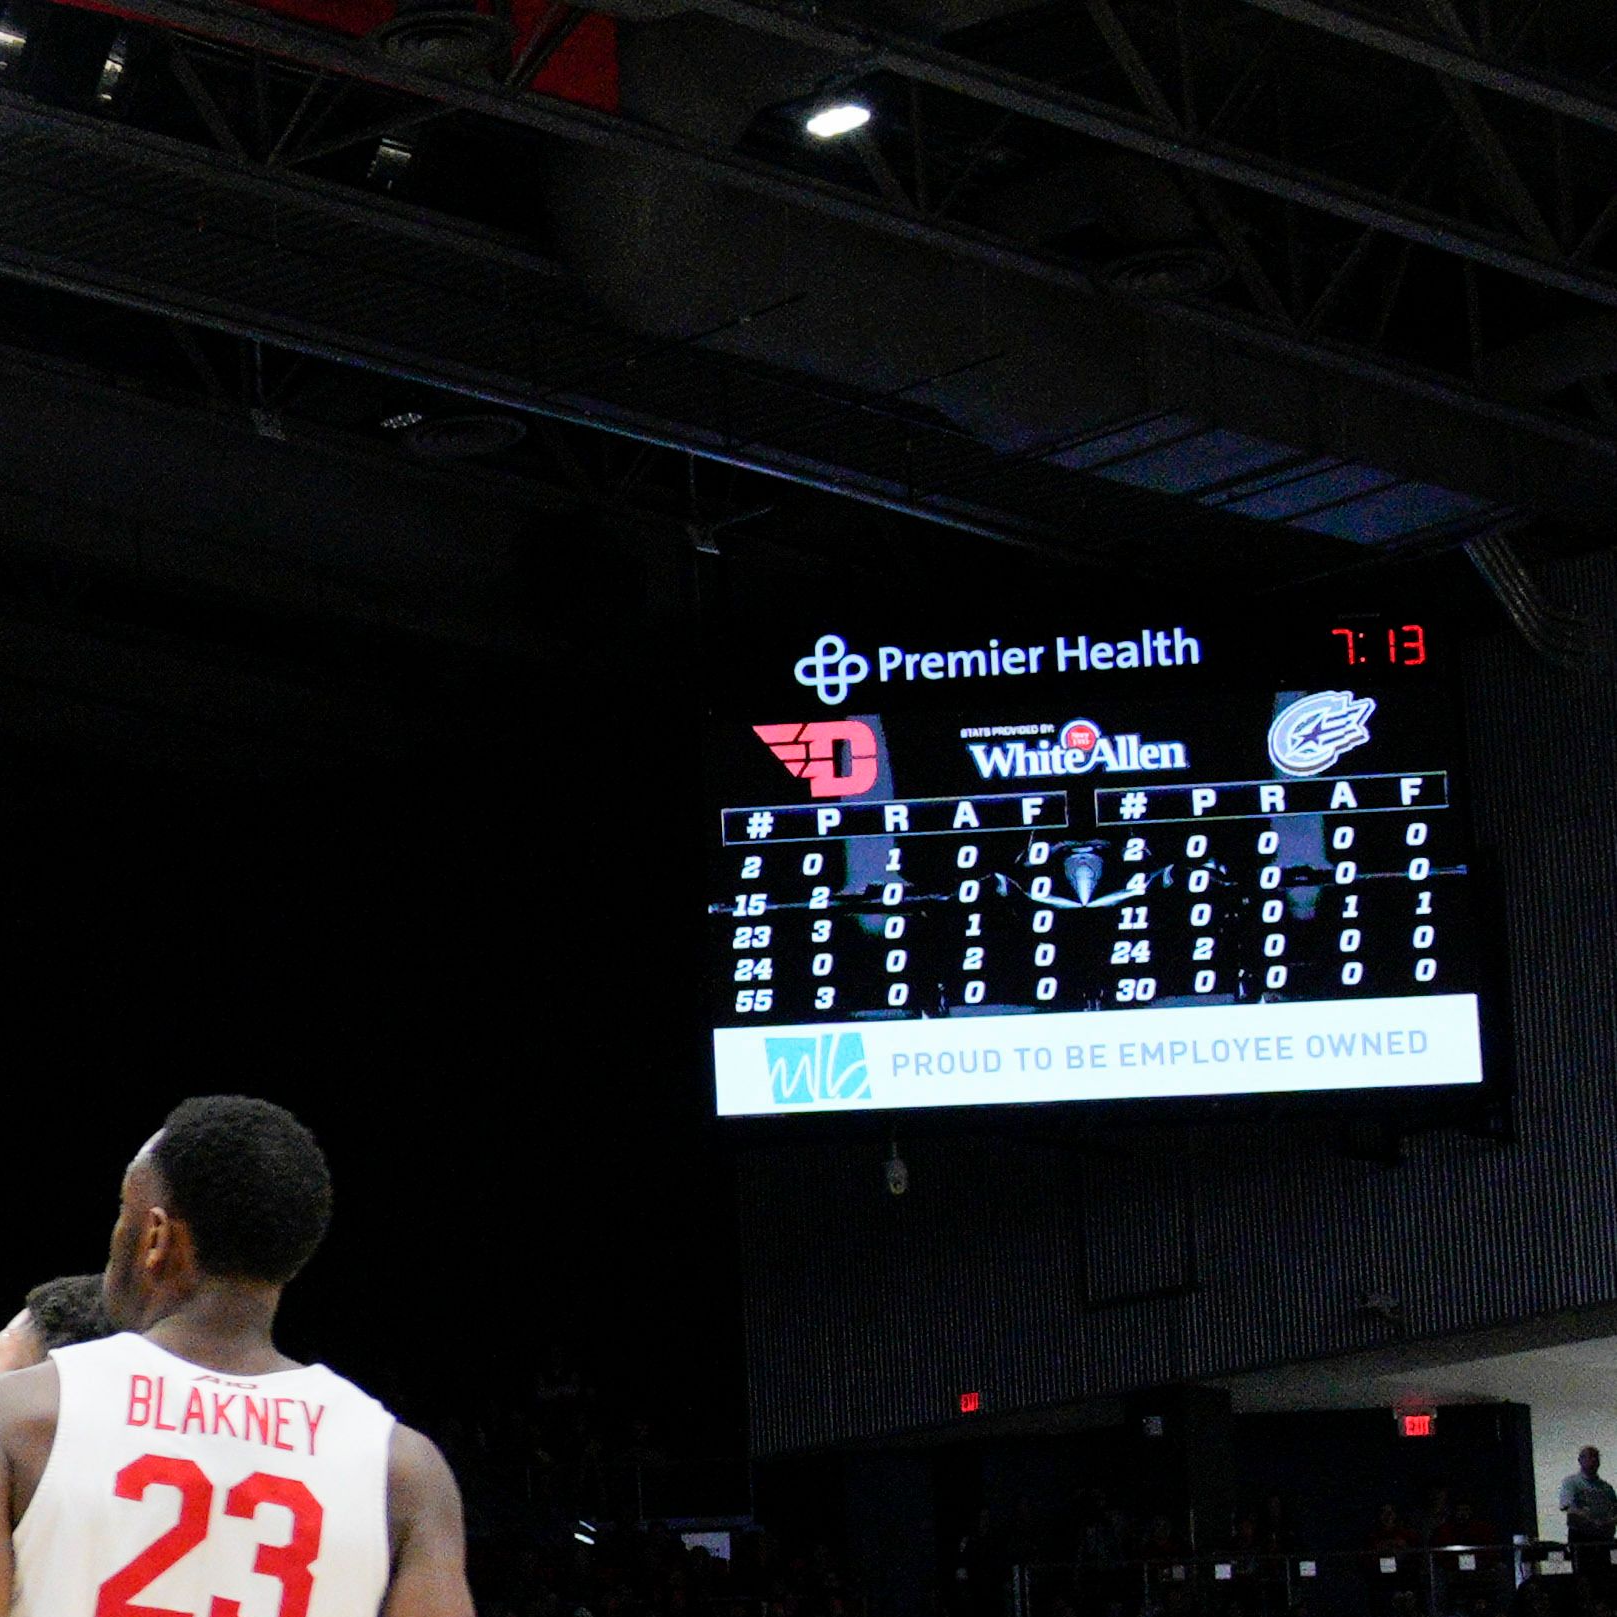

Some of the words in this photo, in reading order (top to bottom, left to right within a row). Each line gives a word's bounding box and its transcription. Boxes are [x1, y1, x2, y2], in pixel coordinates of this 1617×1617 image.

[878, 639, 1044, 682] Premier
[1056, 627, 1200, 672] Health
[1331, 624, 1426, 666] 7:13
[1192, 788, 1217, 816] P
[1260, 785, 1285, 812] R
[1331, 782, 1357, 809] A
[1401, 778, 1422, 805] F
[817, 808, 841, 835] P
[884, 804, 909, 831] R
[953, 802, 979, 828] A
[1022, 798, 1043, 825] F
[741, 856, 762, 879] 2
[803, 854, 823, 875] 0
[886, 849, 902, 871] 1
[957, 846, 978, 868] 0
[1029, 842, 1050, 864] 0
[1124, 839, 1146, 861] 2
[1186, 835, 1207, 857] 0
[1258, 832, 1279, 854] 0
[1333, 827, 1354, 849] 0
[1407, 823, 1427, 845] 0
[1127, 874, 1147, 895] 4
[1188, 871, 1209, 893] 0
[1260, 867, 1281, 888] 0
[1335, 862, 1356, 884] 0
[1409, 858, 1430, 880] 0
[732, 894, 767, 916] 15
[810, 887, 830, 908] 2
[883, 883, 903, 905] 0
[959, 880, 980, 901] 0
[1031, 877, 1051, 898] 0
[1118, 907, 1148, 929] 11
[1191, 904, 1211, 926] 0
[1262, 901, 1283, 923] 0
[1343, 895, 1358, 918] 1
[1415, 892, 1431, 915] 1
[733, 926, 772, 949] 23
[812, 920, 831, 942] 3
[885, 917, 905, 938] 0
[966, 914, 982, 935] 1
[1033, 910, 1053, 932] 0
[1111, 940, 1151, 964] 24
[1193, 938, 1214, 960] 2
[1264, 935, 1285, 957] 0
[1340, 930, 1360, 952] 0
[1413, 926, 1434, 948] 0
[734, 959, 772, 981] 24
[813, 954, 833, 976] 0
[886, 950, 907, 972] 0
[963, 948, 984, 970] 2
[1035, 944, 1055, 966] 0
[1116, 978, 1156, 1001] 30
[1194, 970, 1216, 992] 0
[1266, 966, 1287, 988] 0
[1342, 962, 1363, 984] 0
[1415, 958, 1436, 981] 0
[736, 990, 773, 1012] 55
[815, 987, 835, 1009] 3
[888, 983, 908, 1005] 0
[965, 981, 985, 1003] 0
[1036, 978, 1057, 999] 0
[891, 1050, 1002, 1077] PROUD
[1014, 1047, 1053, 1071] TO
[1066, 1044, 1107, 1070] BE
[1120, 1036, 1294, 1066] EMPLOYEE
[1306, 1030, 1428, 1059] OWNED
[126, 1374, 325, 1456] BLAKNEY
